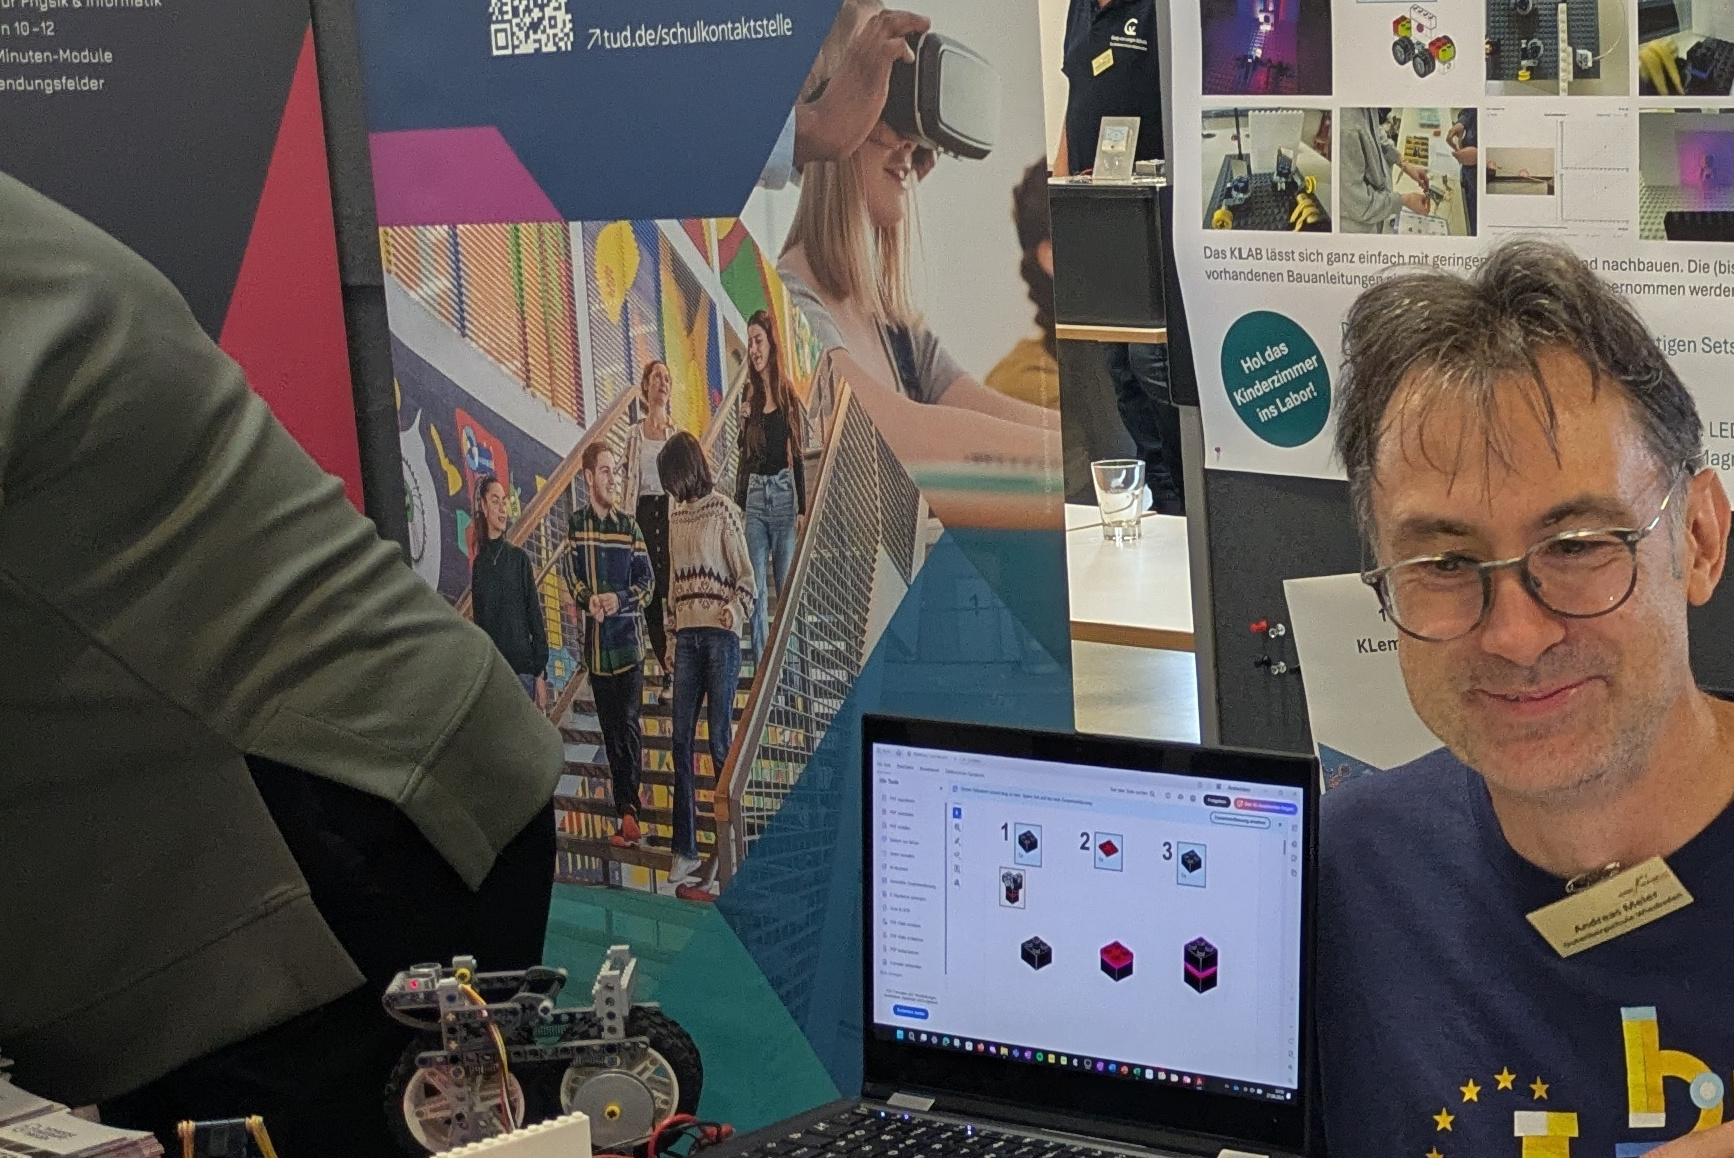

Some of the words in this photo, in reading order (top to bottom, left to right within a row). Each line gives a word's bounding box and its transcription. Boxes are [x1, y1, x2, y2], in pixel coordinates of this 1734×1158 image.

[603, 13, 793, 49] tud.de/schulkontaktstelle
[1203, 246, 1227, 261] Das
[1265, 247, 1295, 263] lässt
[1298, 249, 1323, 264] sich
[1327, 252, 1356, 267] ganz
[1358, 250, 1405, 266] einfach
[1409, 252, 1429, 265] mit
[1602, 258, 1684, 274] nachbauen.
[1687, 259, 1710, 275] Die
[1205, 268, 1284, 284] vorhandenen
[1287, 270, 1382, 289] Bauanleitungen
[1241, 356, 1265, 375] Hol
[1265, 341, 1289, 361] das
[1233, 354, 1319, 406] Kinderzimmer
[1256, 404, 1278, 424] ins
[1279, 382, 1318, 413] Labor!
[1001, 822, 1009, 841] 1
[1079, 832, 1091, 851] 2
[1162, 841, 1173, 860] 3
[1574, 909, 1622, 933] Andreas
